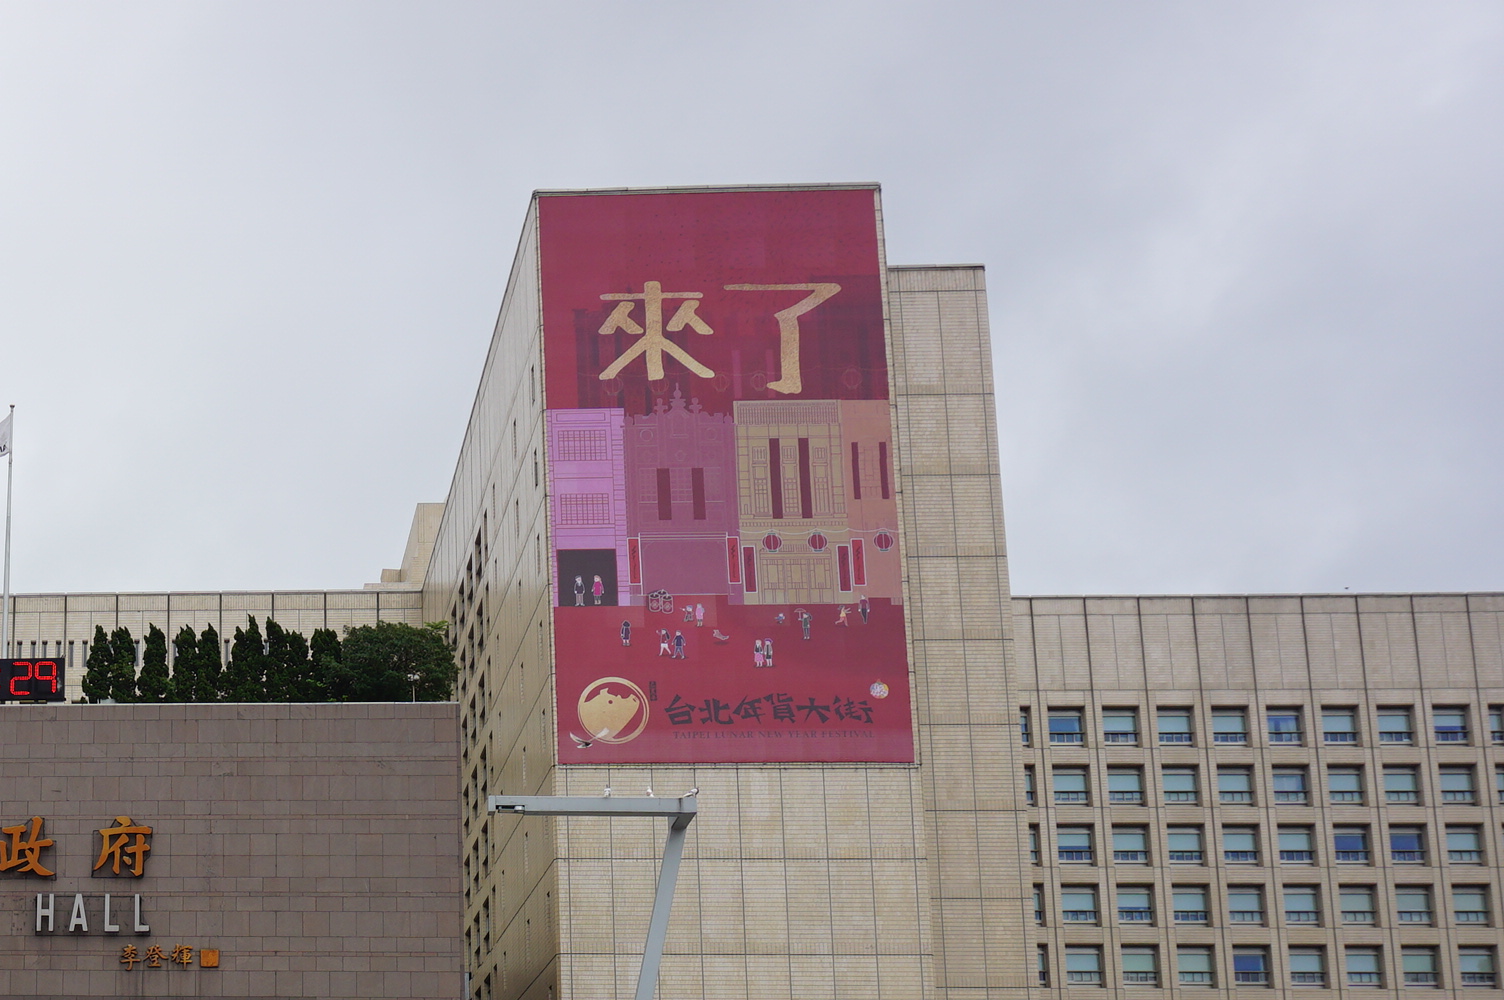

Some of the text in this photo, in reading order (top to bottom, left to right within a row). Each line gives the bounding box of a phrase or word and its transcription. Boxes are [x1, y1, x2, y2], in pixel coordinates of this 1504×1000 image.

[598, 280, 842, 394] 來了
[664, 693, 875, 725] 台北年貨大街
[672, 730, 875, 740] TAIPEI LUNAR NEW YEAR FESTIVAL
[35, 893, 151, 933] HALL
[118, 943, 193, 972] 李登輝
